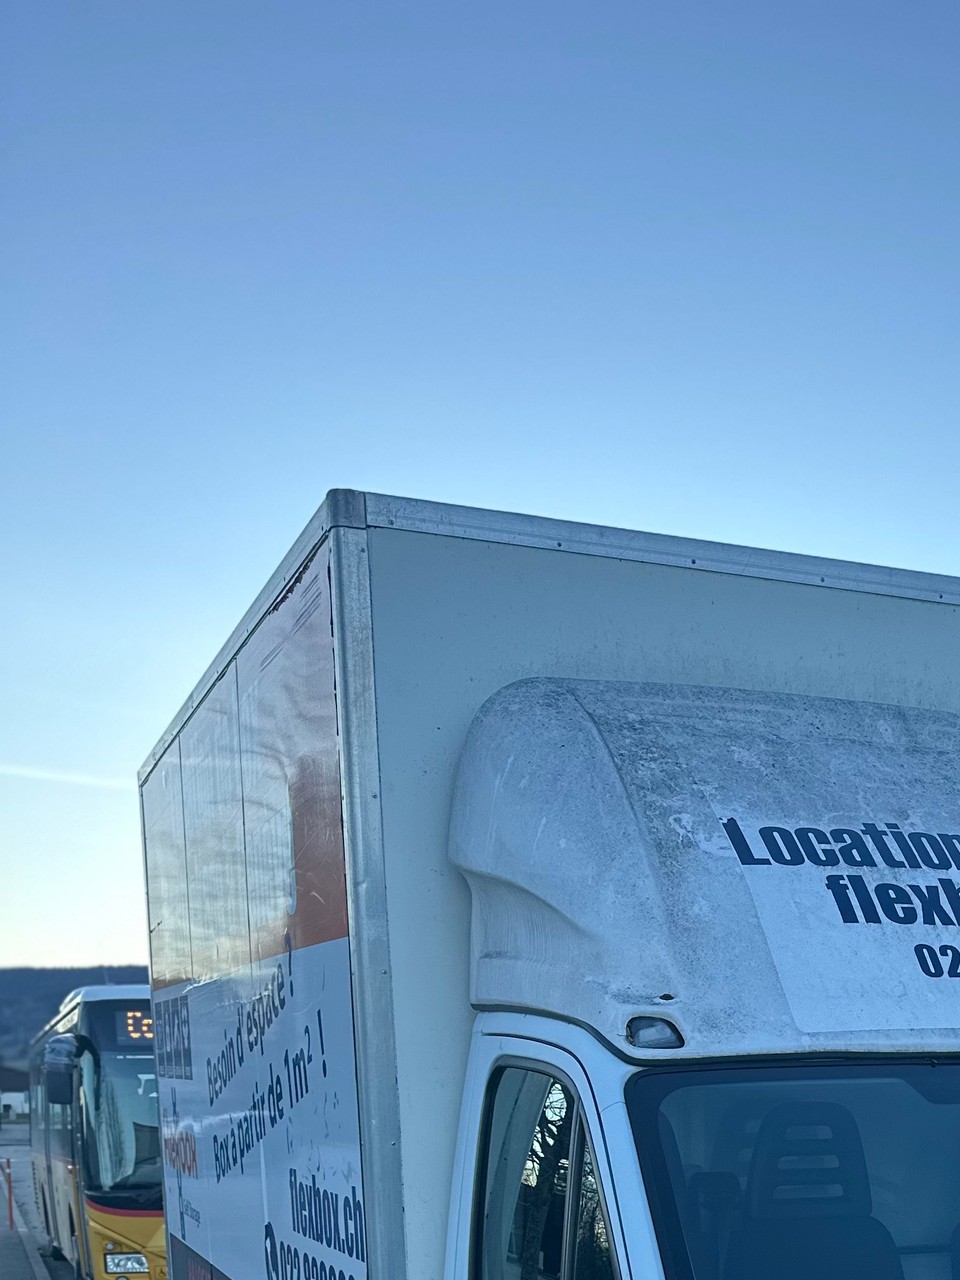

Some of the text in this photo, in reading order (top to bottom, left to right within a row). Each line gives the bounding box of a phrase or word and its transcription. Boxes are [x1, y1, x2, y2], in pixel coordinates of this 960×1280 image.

[206, 1028, 237, 1107] Besoin
[212, 1134, 231, 1184] Box
[237, 1081, 266, 1175] partir
[267, 1063, 285, 1128] de
[289, 1167, 365, 1262] flexbox.ch
